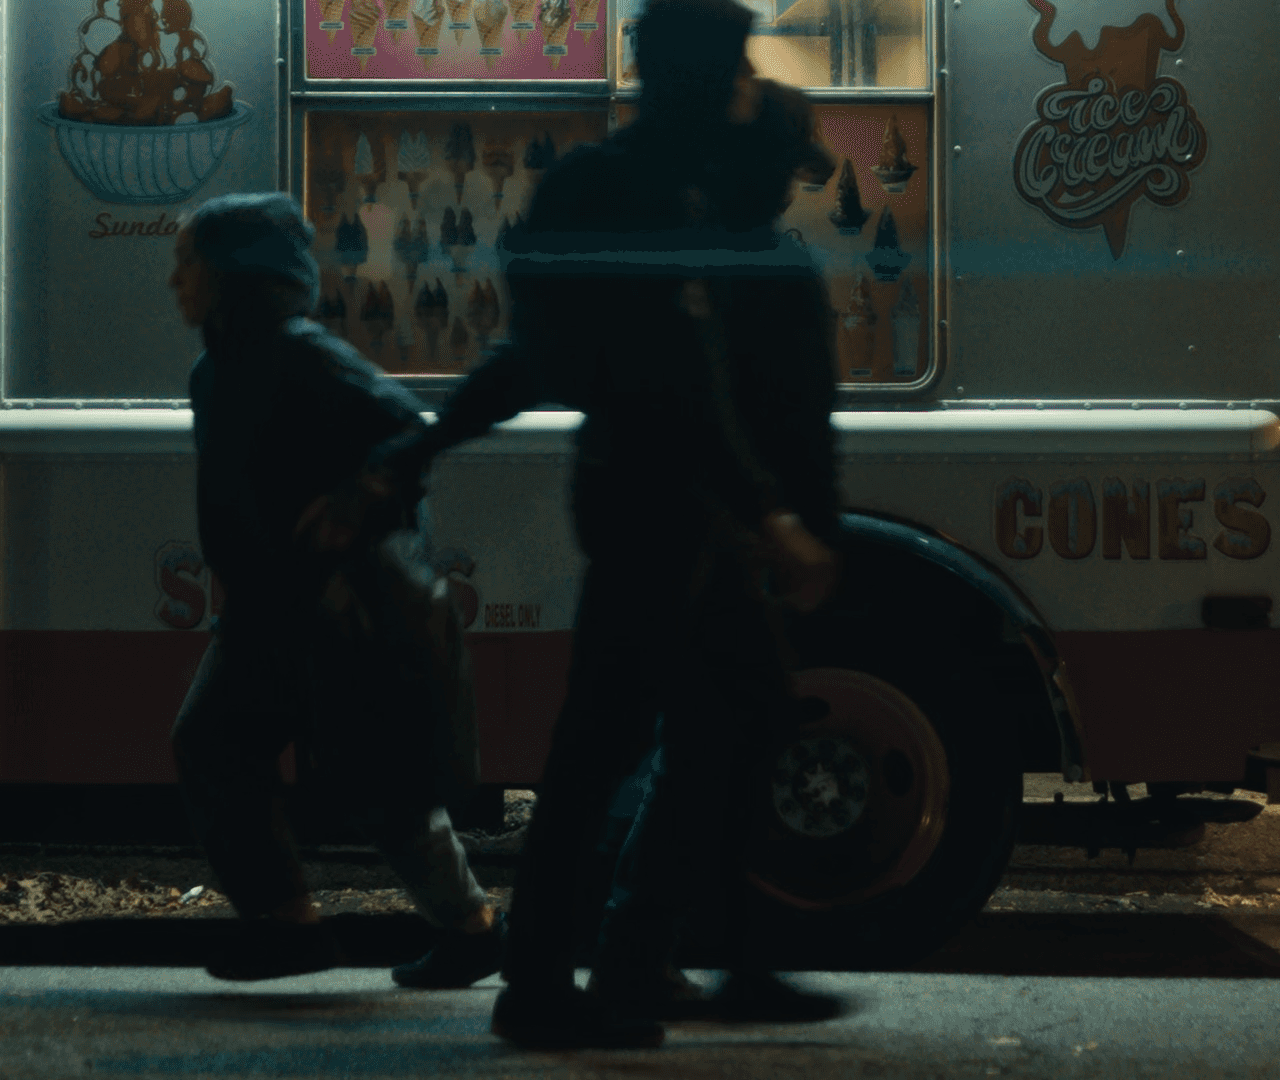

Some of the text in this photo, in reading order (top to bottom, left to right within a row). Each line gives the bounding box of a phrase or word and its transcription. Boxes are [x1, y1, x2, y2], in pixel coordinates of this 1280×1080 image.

[1041, 76, 1182, 134] Ice
[1018, 105, 1201, 200] Cream
[88, 212, 182, 240] Sunda
[993, 475, 1272, 561] CONES
[484, 602, 542, 629] DIESEL ONLY
